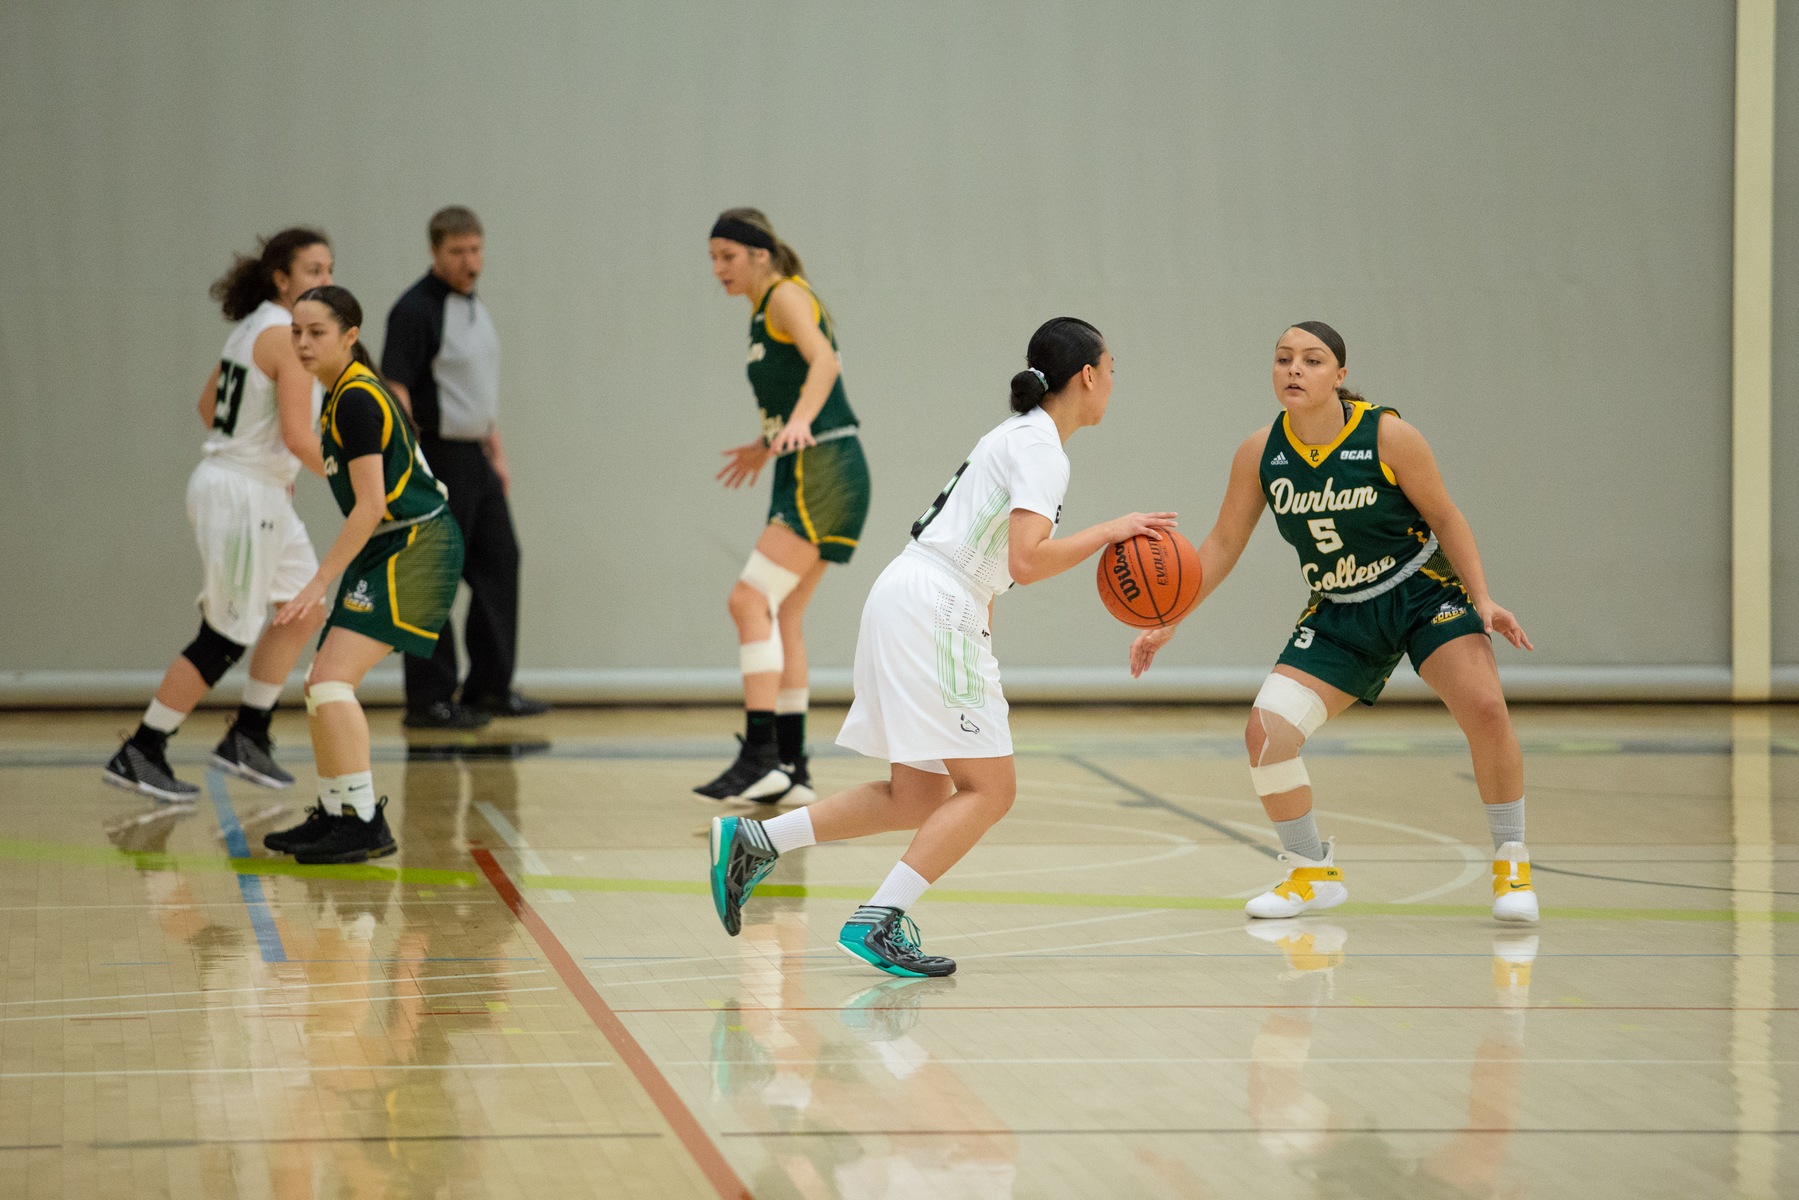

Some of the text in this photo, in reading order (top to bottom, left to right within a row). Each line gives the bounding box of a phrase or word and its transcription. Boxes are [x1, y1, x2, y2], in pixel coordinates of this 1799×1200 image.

[1340, 449, 1373, 461] OCAA
[1269, 477, 1378, 515] Durham
[1307, 517, 1345, 555] 5
[1302, 554, 1396, 592] College
